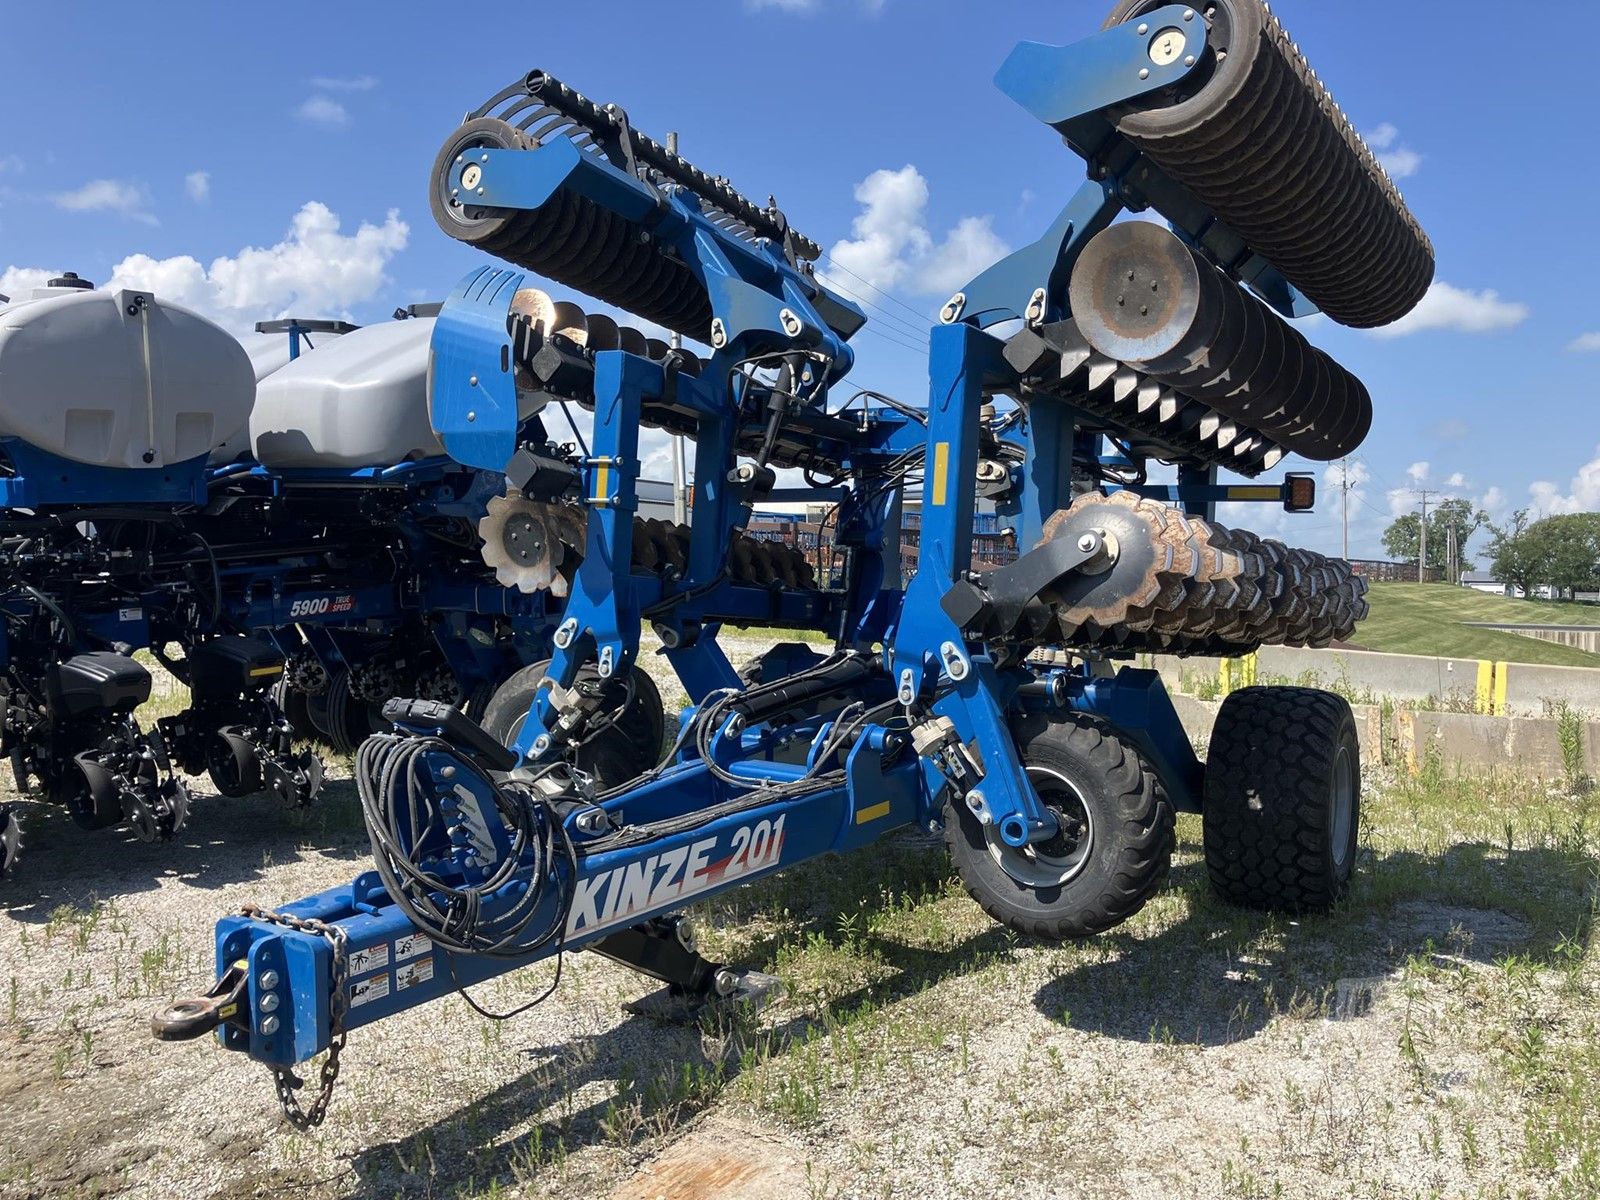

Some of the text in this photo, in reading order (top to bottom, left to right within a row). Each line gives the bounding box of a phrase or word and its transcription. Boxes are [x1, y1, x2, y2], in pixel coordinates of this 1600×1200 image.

[290, 597, 330, 617] 5900
[332, 603, 352, 613] SPEED
[565, 813, 786, 938] KINZE 201
